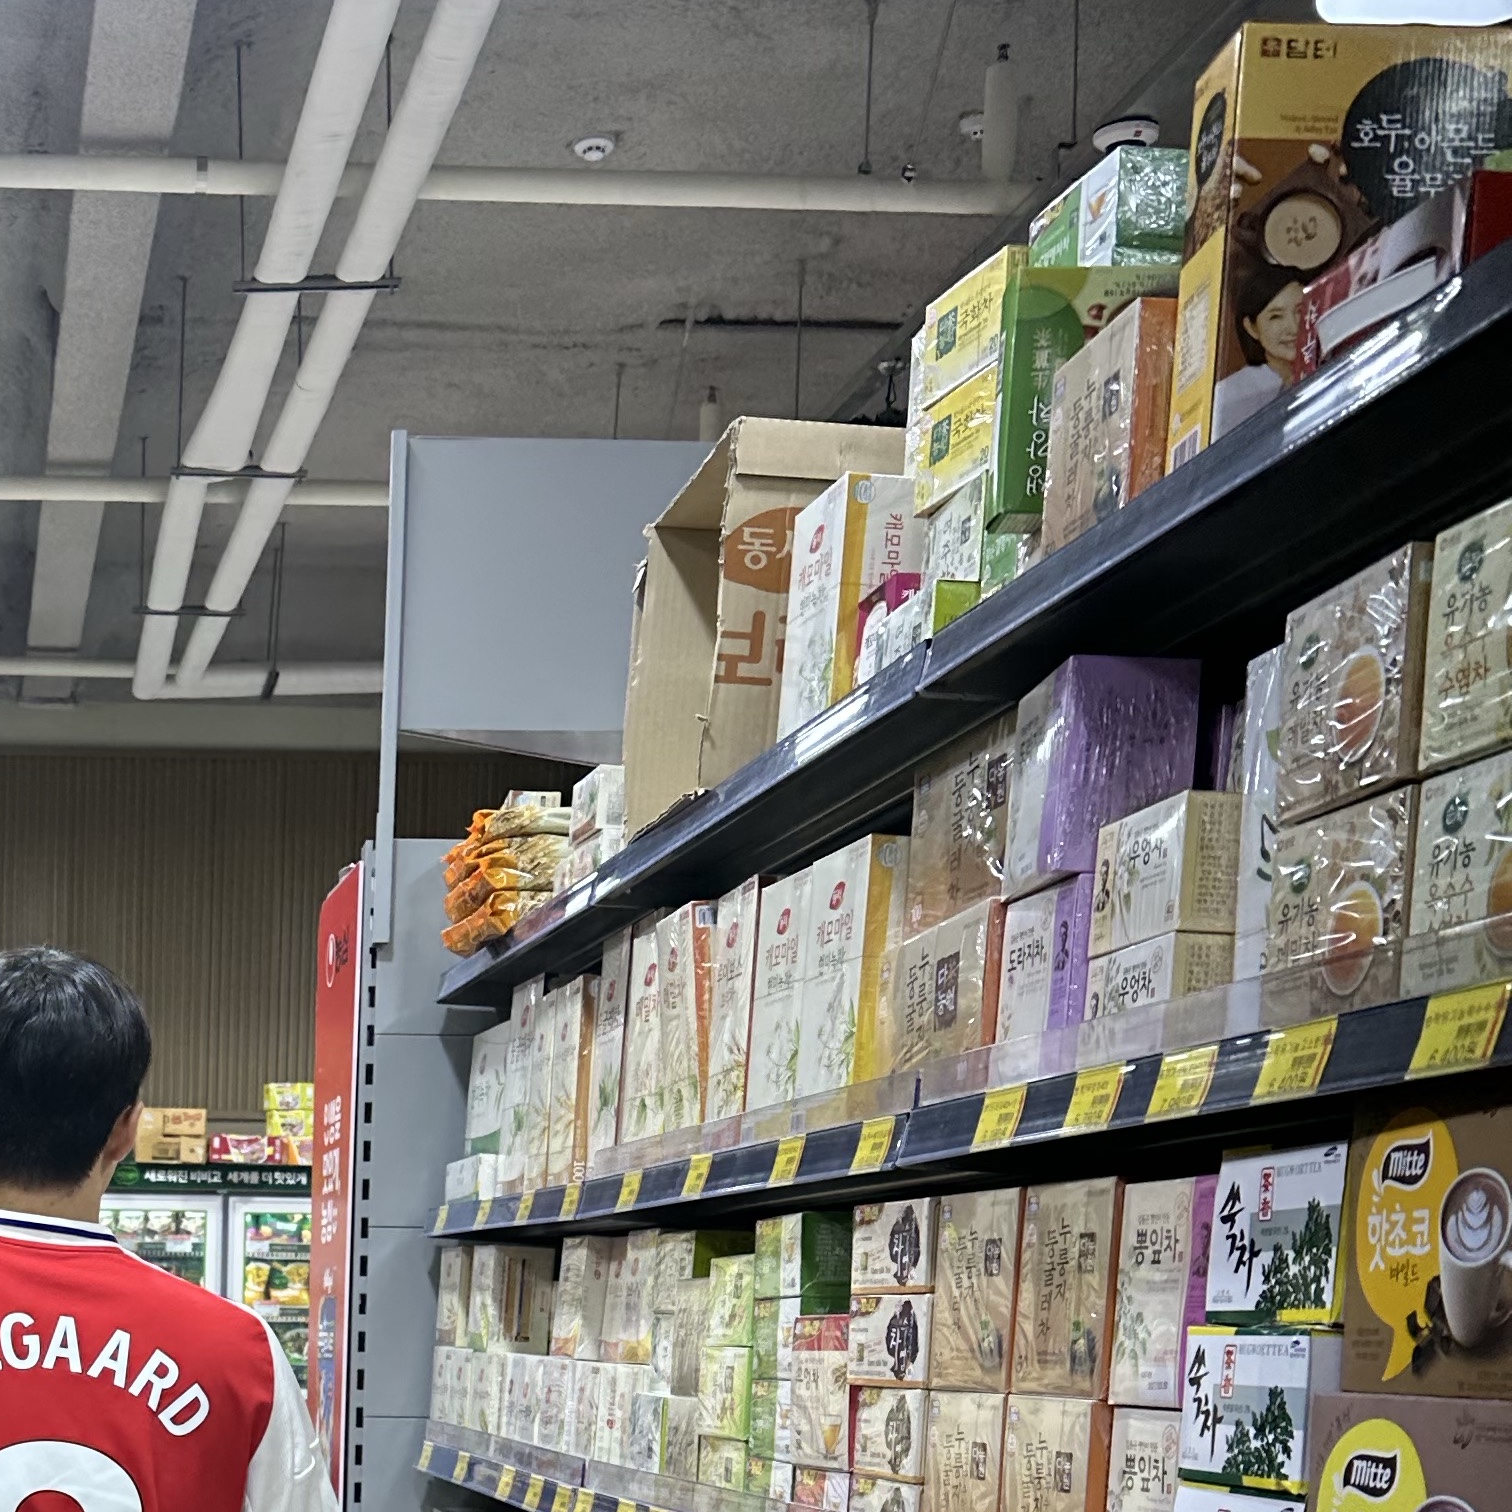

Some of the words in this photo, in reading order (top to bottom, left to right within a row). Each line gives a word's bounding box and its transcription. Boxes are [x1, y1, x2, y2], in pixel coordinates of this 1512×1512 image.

[1443, 586, 1492, 624] 유기농
[1439, 663, 1491, 699] 수염차
[1432, 838, 1476, 877] 유기농
[1007, 939, 1045, 972] 도라지차
[1119, 972, 1154, 1005] 우엉차
[1390, 1143, 1425, 1178] Mitte
[144, 1171, 188, 1184] 새로워진
[190, 1172, 222, 1183] 비비고
[261, 1172, 273, 1184] 더
[274, 1172, 307, 1186] 맛있게
[1132, 1225, 1180, 1265] 뽕잎차
[1369, 1209, 1431, 1273] 핫초코
[1389, 1264, 1420, 1287] 마일드
[1122, 1454, 1167, 1495] 뽕잎차
[1352, 1457, 1392, 1490] Mitte
